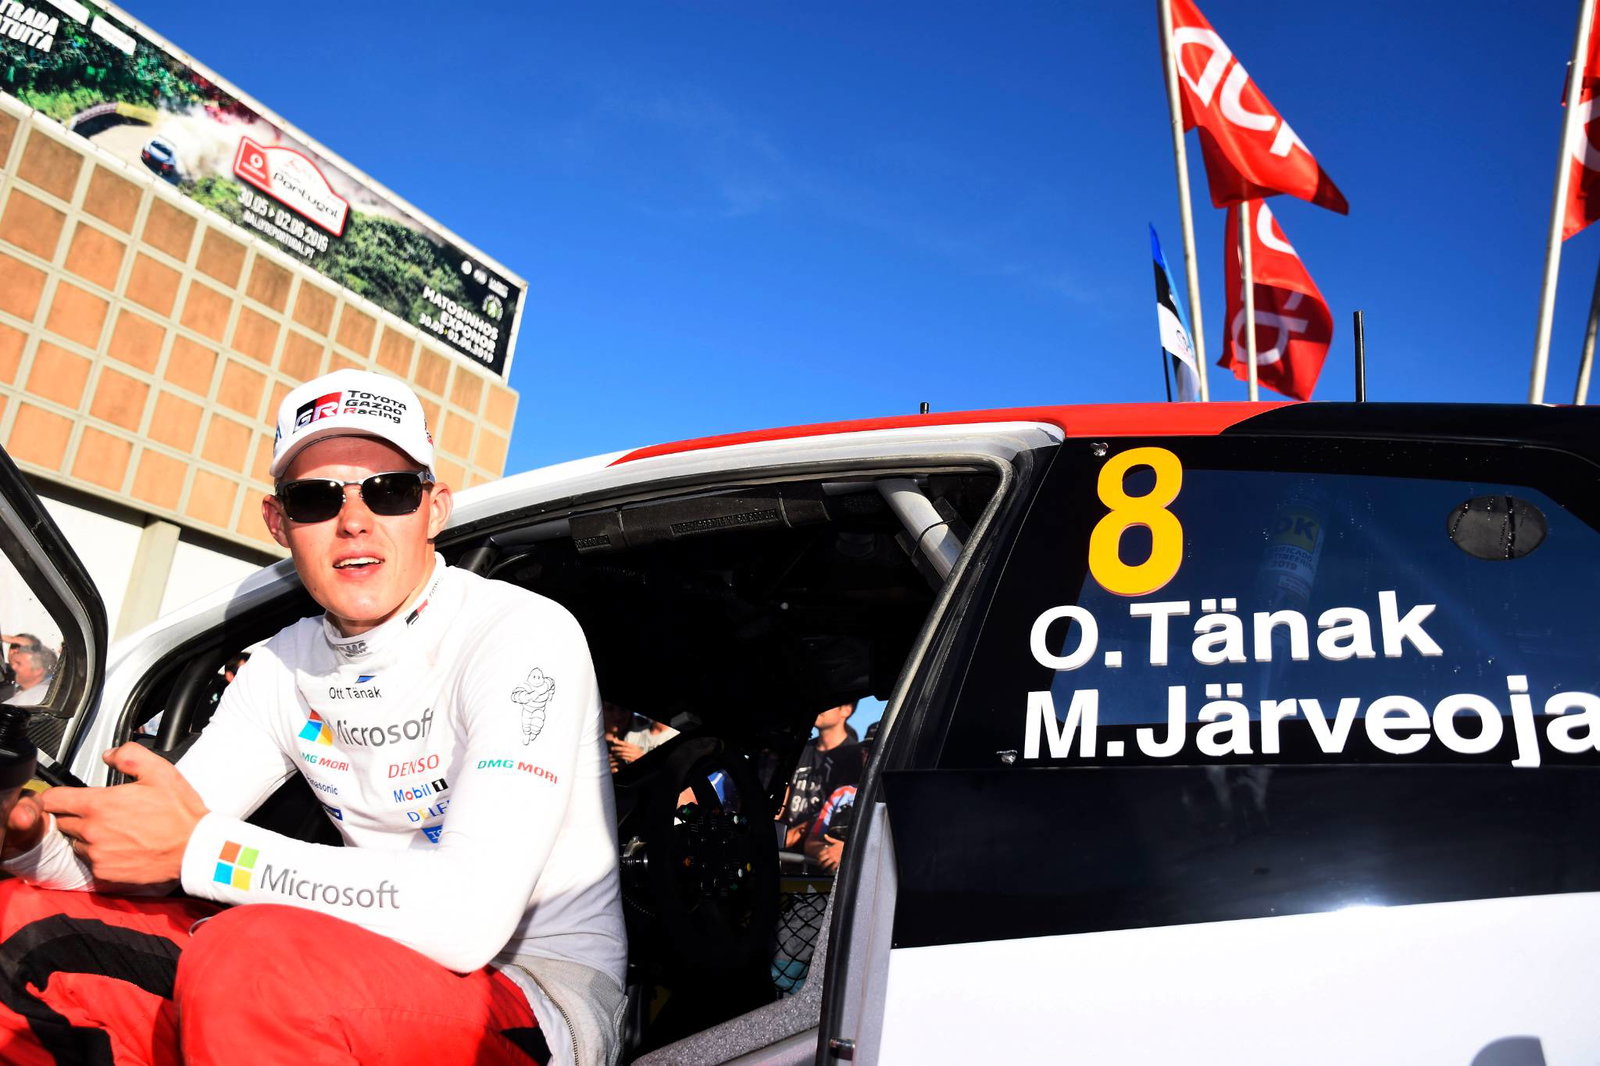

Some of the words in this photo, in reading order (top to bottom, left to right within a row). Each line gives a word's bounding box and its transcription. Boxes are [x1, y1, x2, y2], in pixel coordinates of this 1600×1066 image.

[0, 14, 54, 53] TUITA
[273, 171, 338, 219] Portugal
[423, 285, 498, 340] MATOSINHOS
[440, 310, 496, 353] EXPONOR
[345, 399, 402, 416] GAZOO
[347, 390, 407, 411] TOYOTA
[294, 402, 339, 428] GR
[343, 407, 401, 424] Racing
[1089, 446, 1184, 598] 8
[329, 687, 345, 699] Ott
[346, 686, 382, 699] Tänak
[319, 757, 349, 771] MORI
[388, 754, 440, 779] DENSO
[477, 759, 514, 770] DMG
[517, 761, 558, 785] MORI
[393, 783, 432, 803] Mobil
[260, 864, 400, 909] Microsoft
